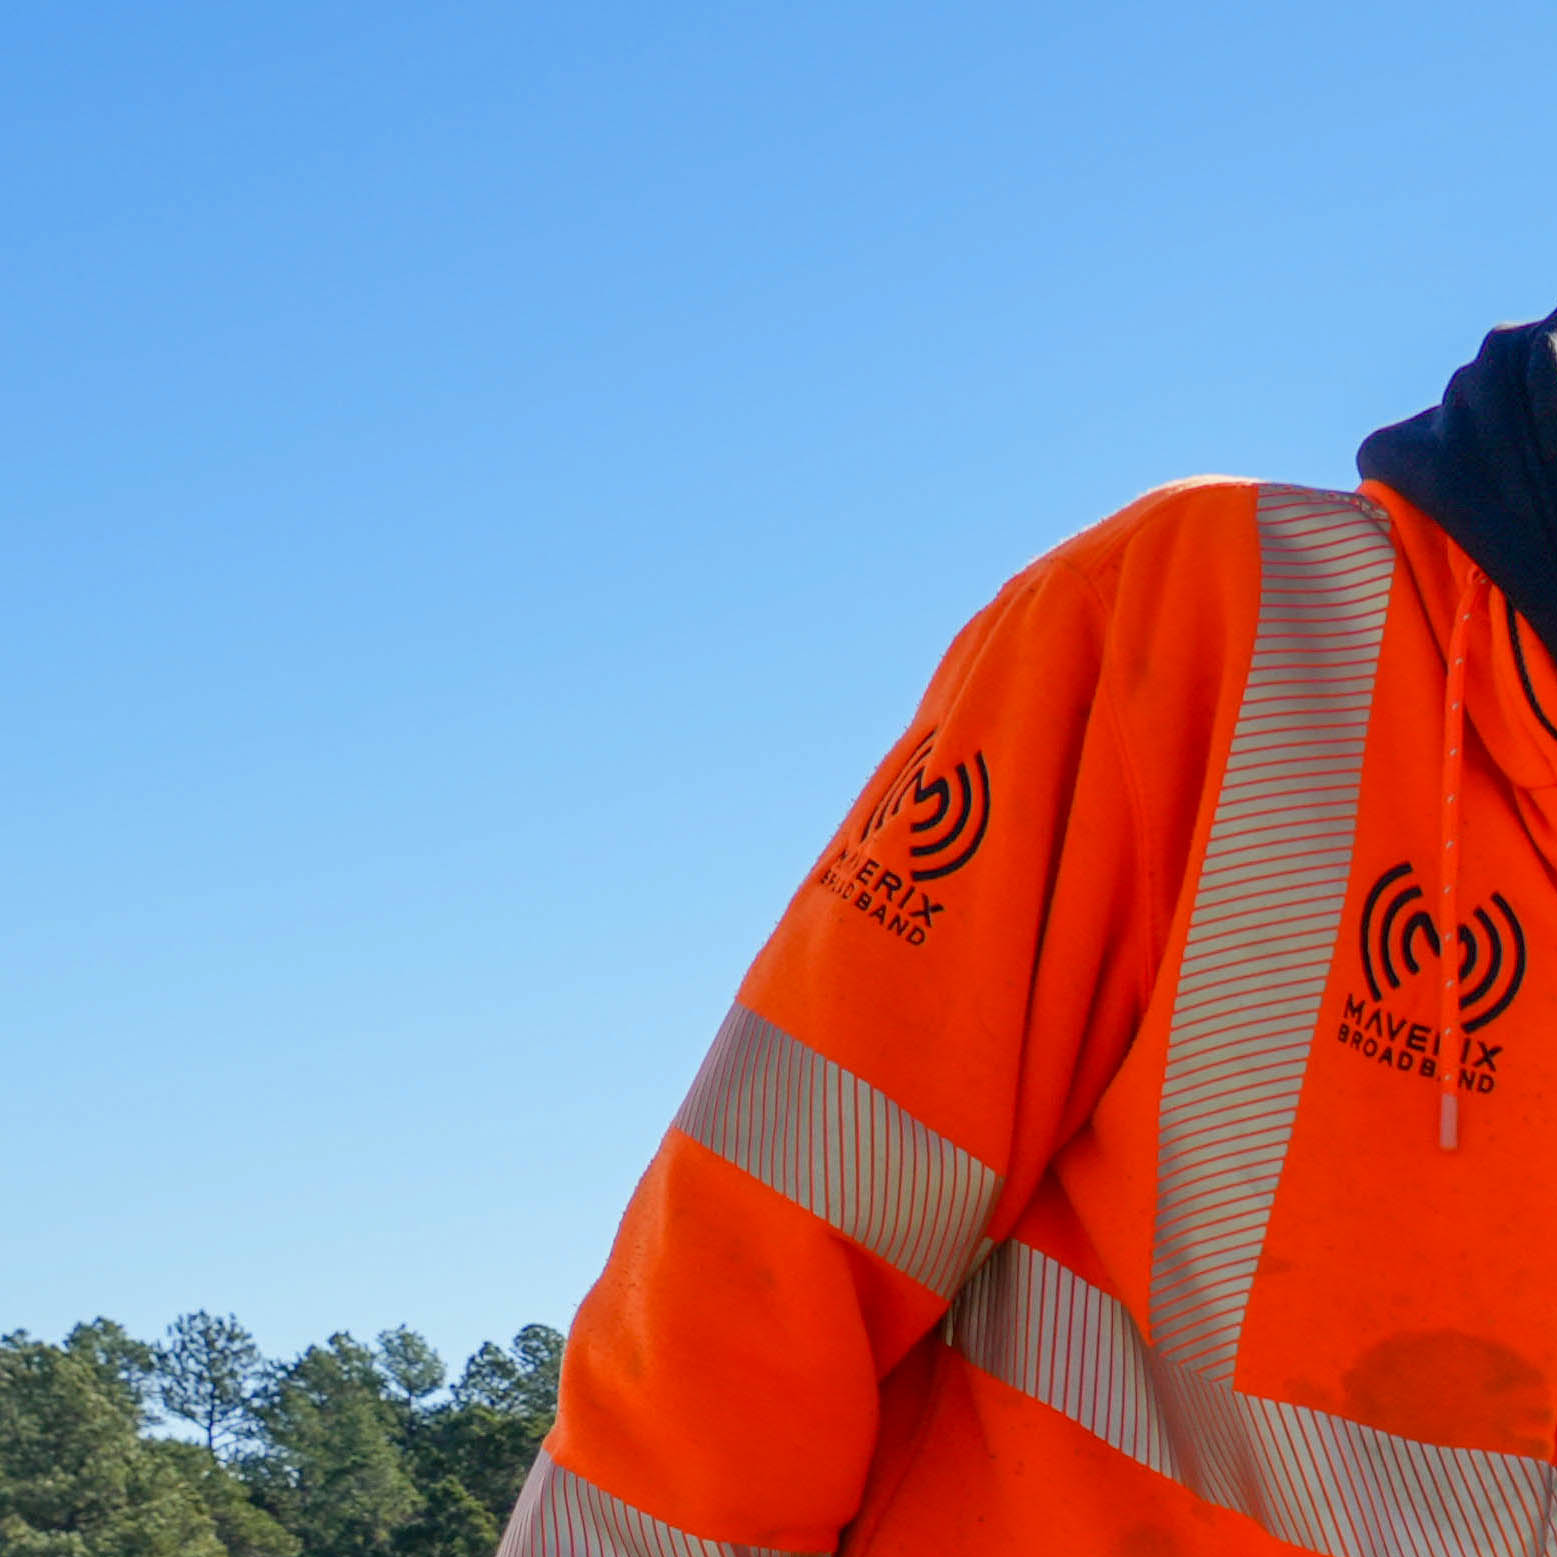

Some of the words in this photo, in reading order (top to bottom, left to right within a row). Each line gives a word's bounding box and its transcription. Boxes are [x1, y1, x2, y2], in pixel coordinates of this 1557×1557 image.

[820, 866, 926, 947] BDBAND
[838, 849, 946, 928] ERIX
[1337, 1022, 1495, 1094] BROADBND
